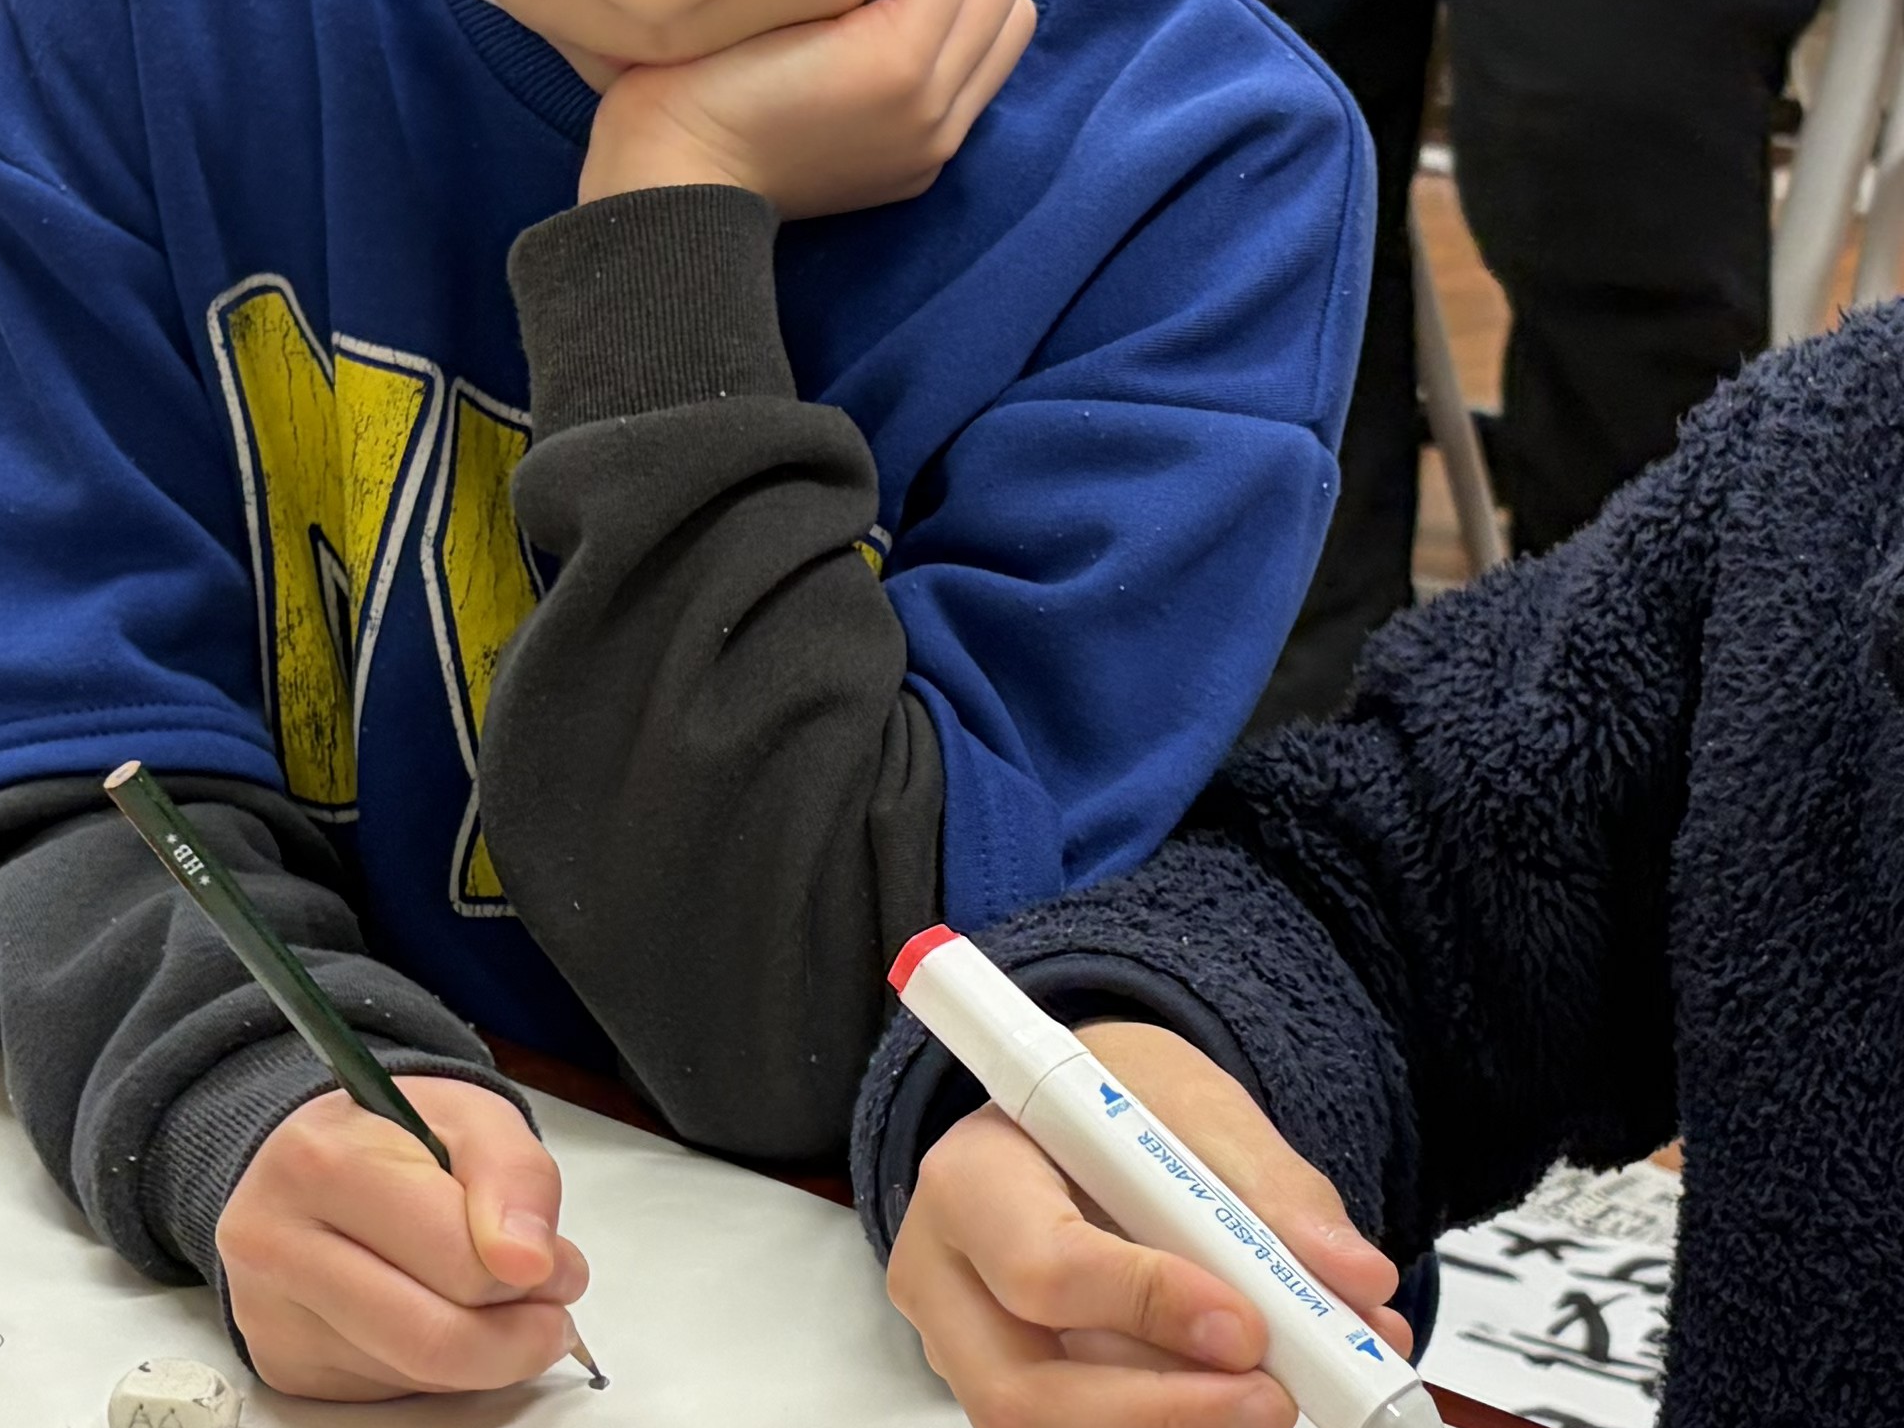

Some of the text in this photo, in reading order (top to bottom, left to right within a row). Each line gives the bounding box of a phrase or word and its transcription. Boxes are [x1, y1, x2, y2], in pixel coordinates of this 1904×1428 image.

[171, 842, 205, 877] HB
[1137, 1130, 1214, 1200] MARKER
[1214, 1206, 1329, 1318] WATER-BASED
